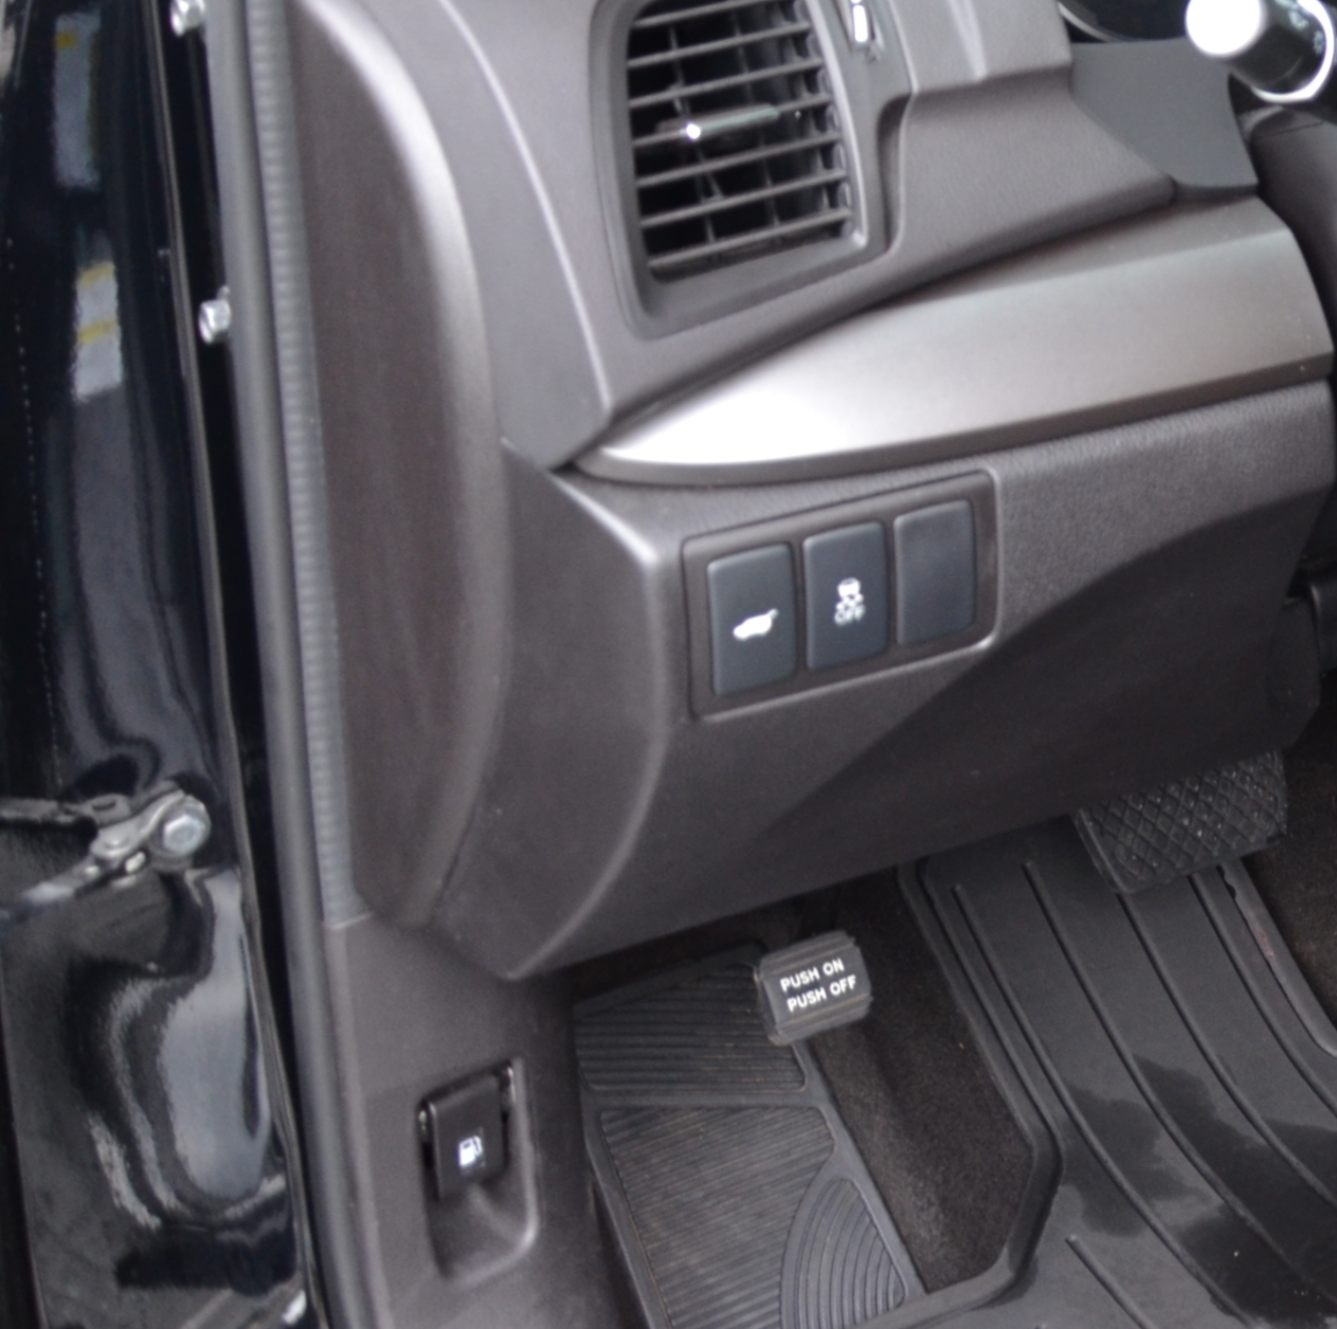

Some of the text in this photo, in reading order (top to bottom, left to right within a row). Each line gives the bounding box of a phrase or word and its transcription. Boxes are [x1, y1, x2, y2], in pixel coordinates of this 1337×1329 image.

[834, 604, 866, 625] OFF
[780, 957, 845, 992] PUSH ON
[787, 974, 857, 1013] PUSH OFF
